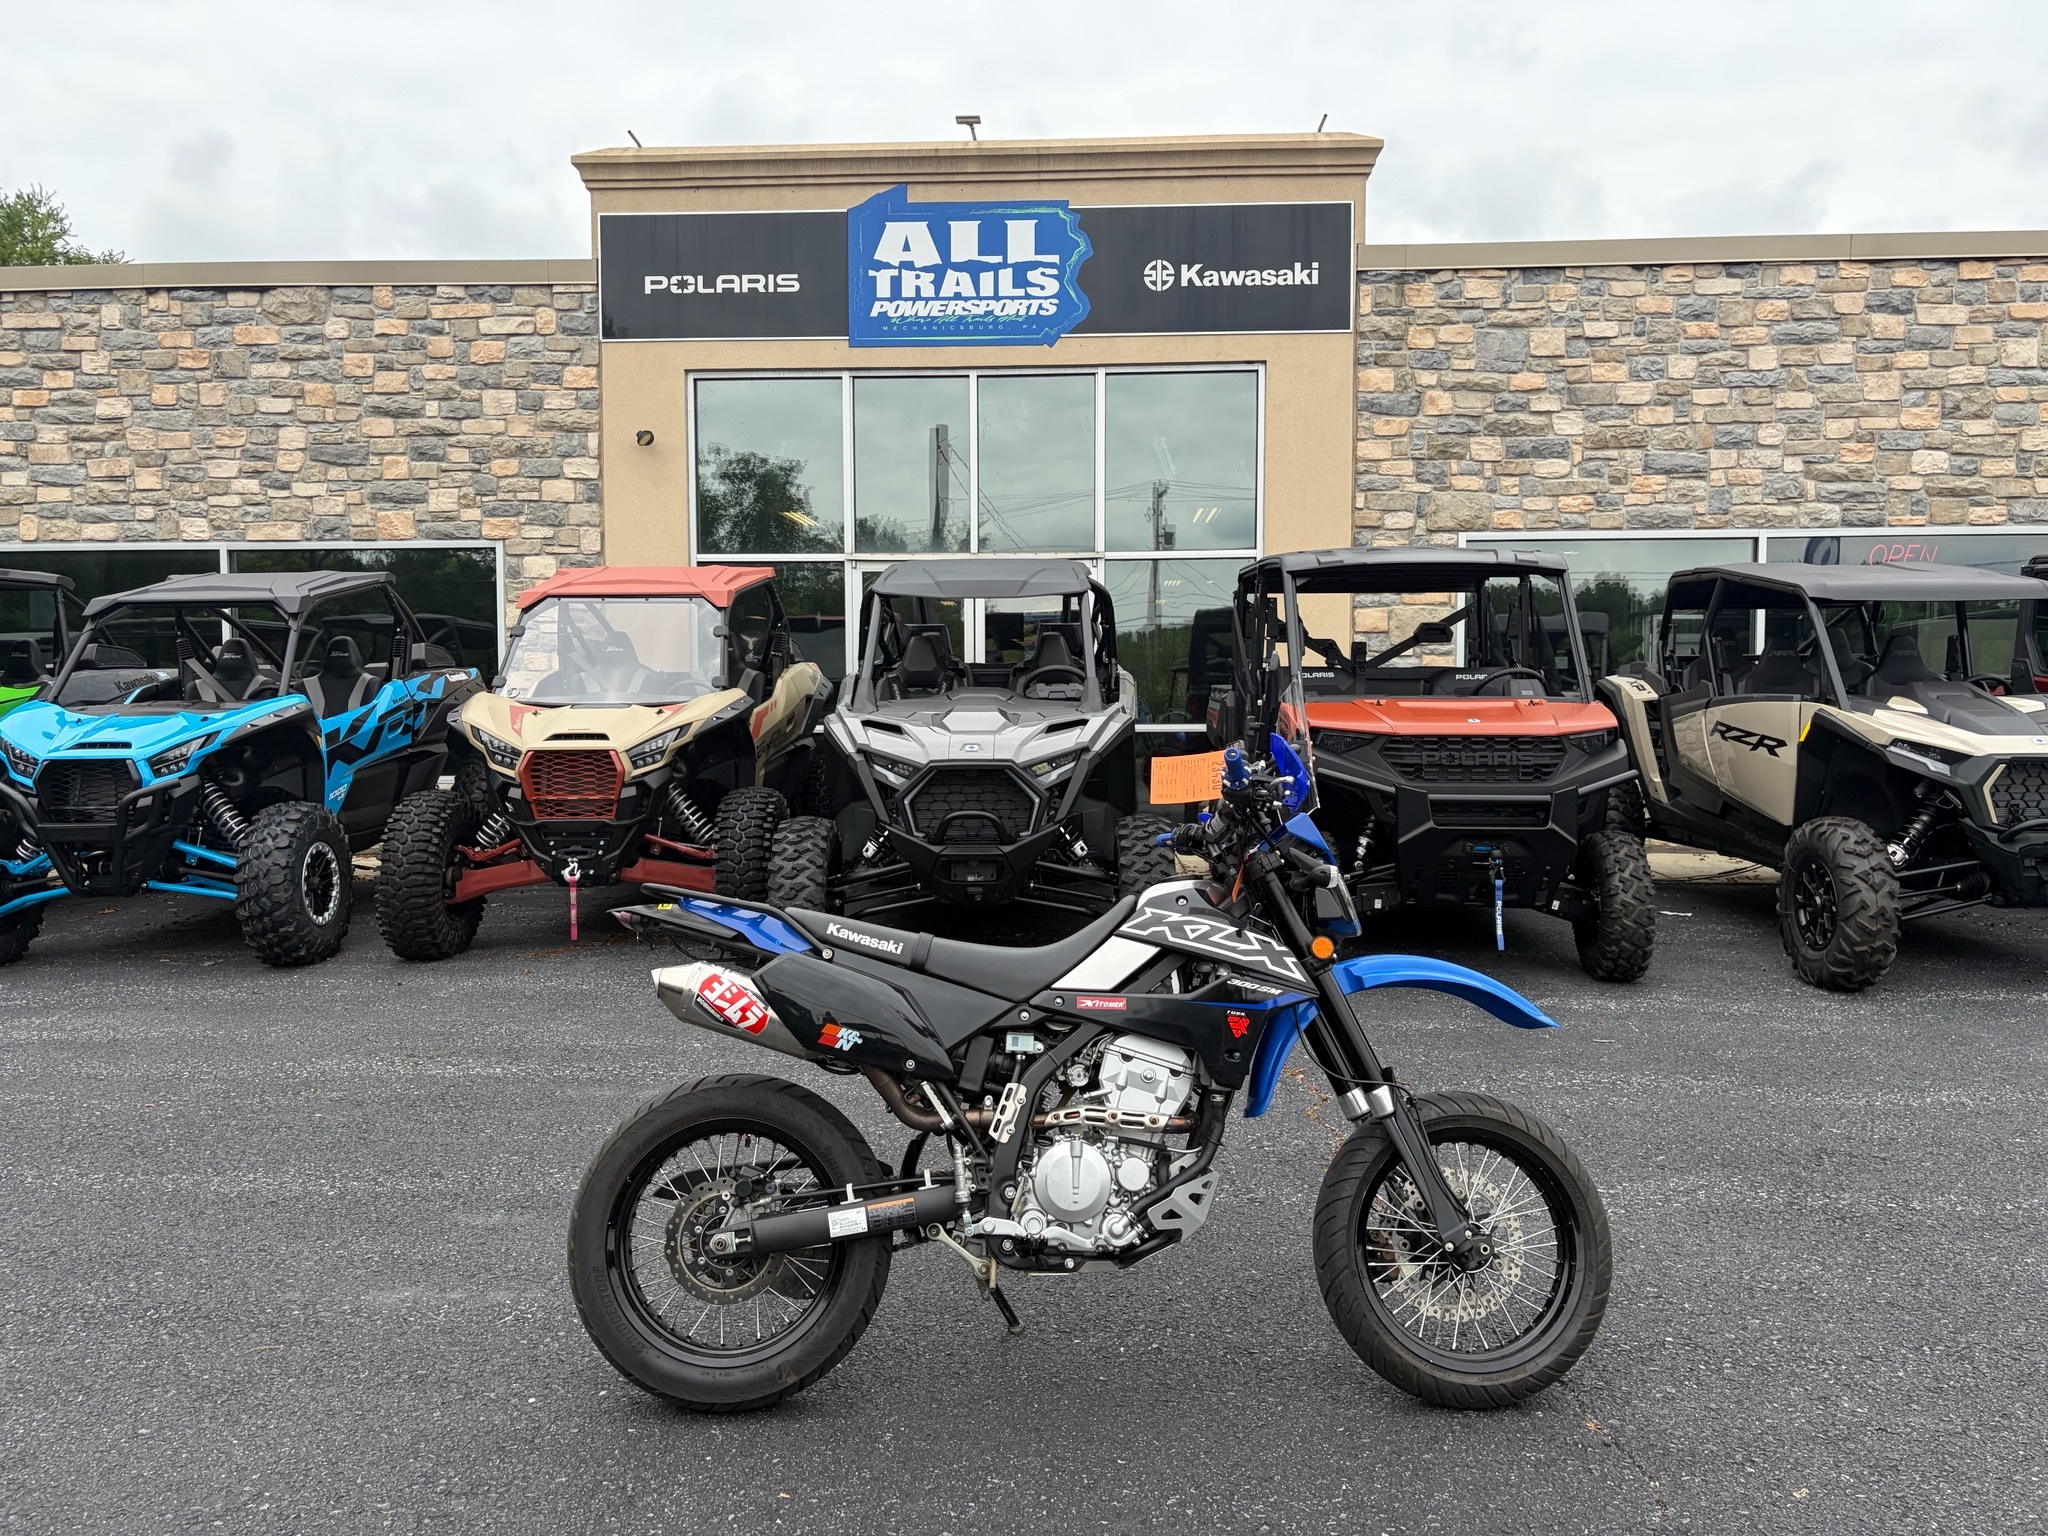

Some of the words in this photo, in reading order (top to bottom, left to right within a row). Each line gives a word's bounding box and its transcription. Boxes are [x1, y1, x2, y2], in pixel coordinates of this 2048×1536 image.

[873, 219, 1060, 268] ALL
[644, 274, 801, 295] POLARIS
[868, 267, 1060, 298] TRAILS
[1180, 262, 1319, 287] Kawasaki
[870, 299, 1060, 317] POWERSPORTS
[1869, 544, 1939, 566] OPEN
[1709, 720, 1788, 758] RZR
[1421, 751, 1536, 766] POLARIS
[1495, 901, 1503, 935] POLARIS
[826, 922, 904, 954] Kawasaki
[1118, 906, 1307, 983] KLX
[591, 1264, 649, 1357] BRIDGESTONE
